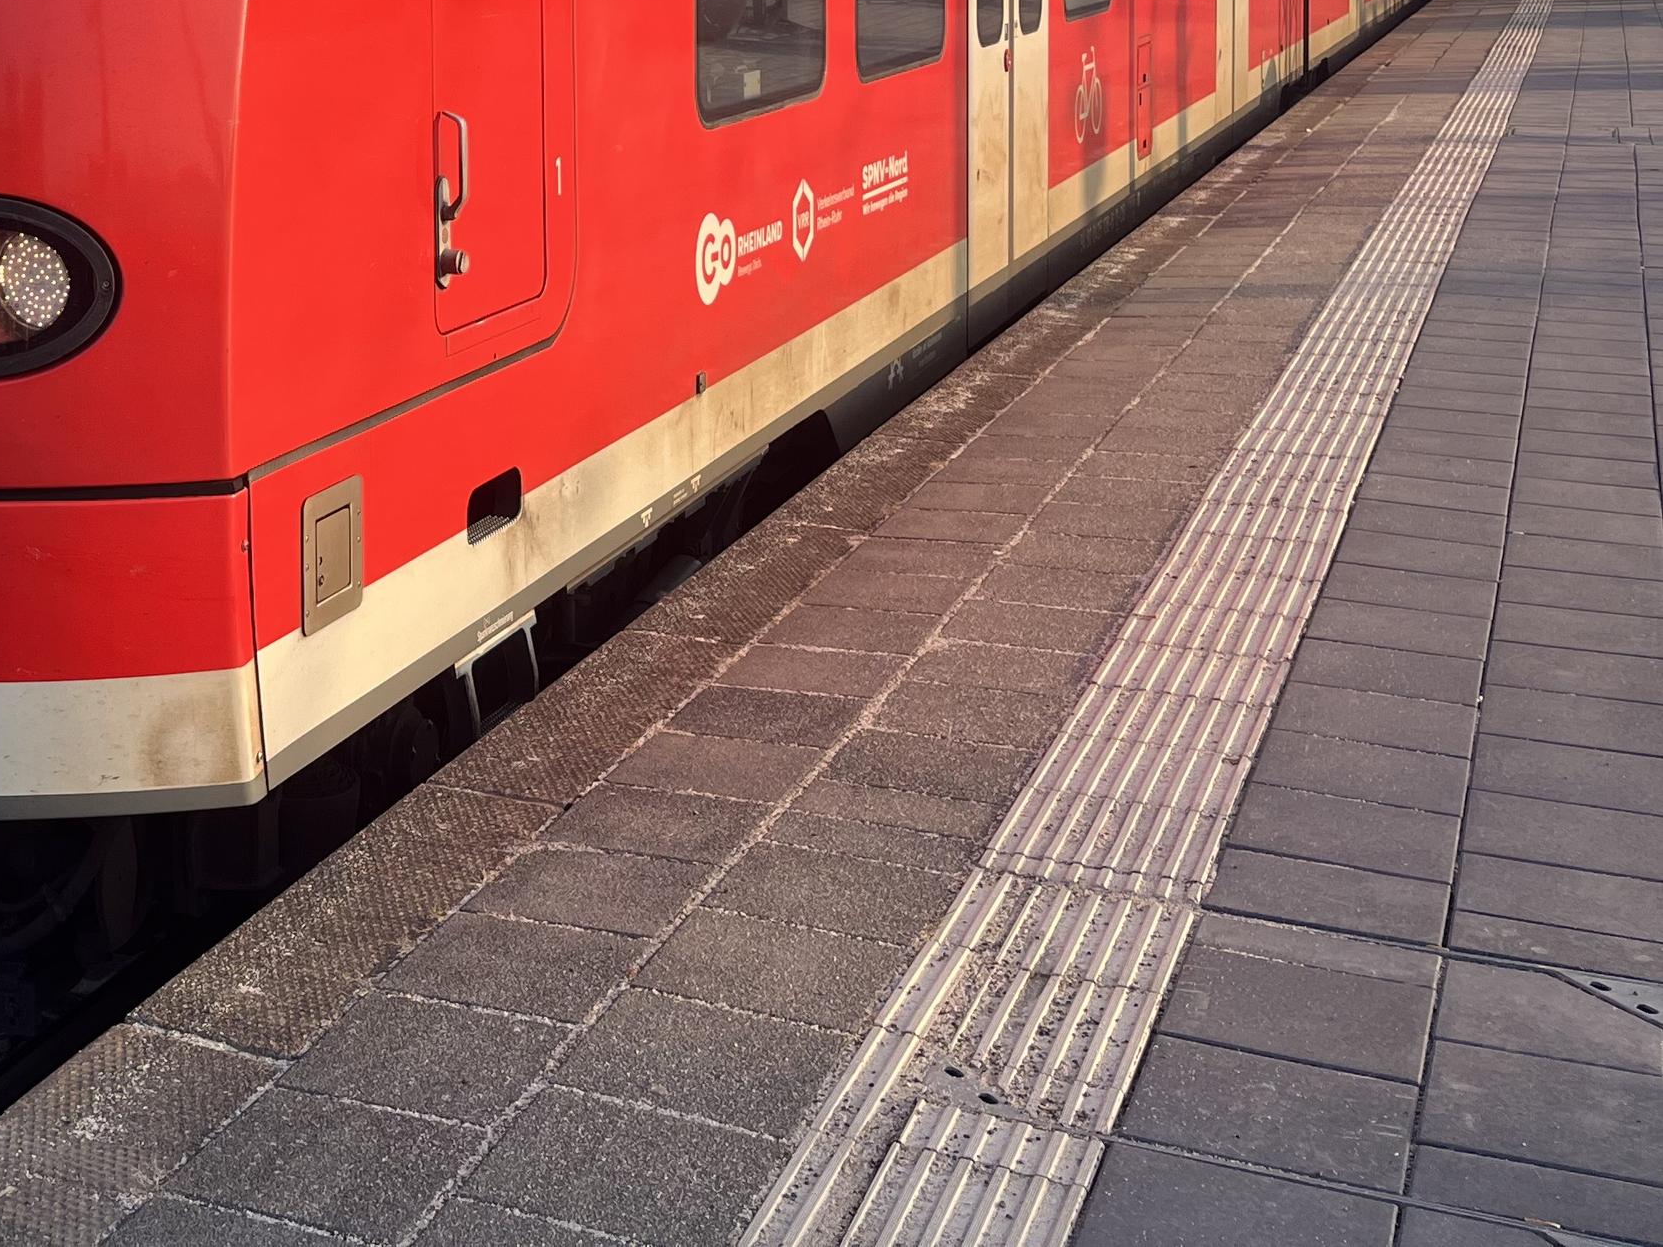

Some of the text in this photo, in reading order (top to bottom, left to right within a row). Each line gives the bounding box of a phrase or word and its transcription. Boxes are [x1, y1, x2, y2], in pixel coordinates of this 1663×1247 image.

[555, 156, 562, 196] 1
[862, 150, 908, 190] SPNV-Nord
[738, 220, 783, 257] RHEINLAND
[797, 211, 809, 230] VRR
